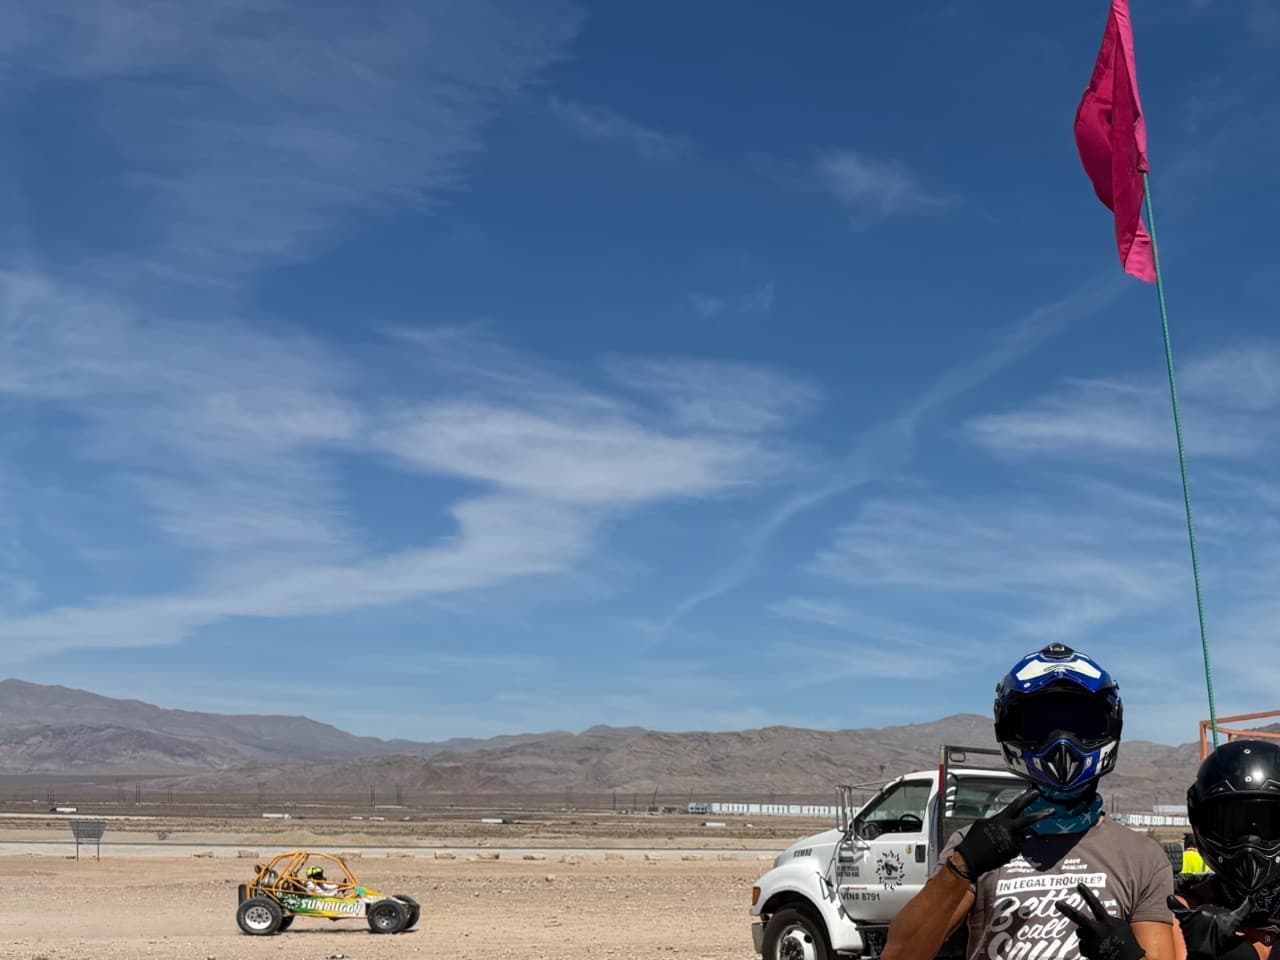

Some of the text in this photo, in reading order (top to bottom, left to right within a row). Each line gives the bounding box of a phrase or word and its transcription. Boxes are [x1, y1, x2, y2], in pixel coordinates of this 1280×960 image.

[999, 876, 1102, 891] IN LEGAL TROUBLE?
[300, 898, 361, 916] SUNBUGGY
[1016, 916, 1071, 940] call
